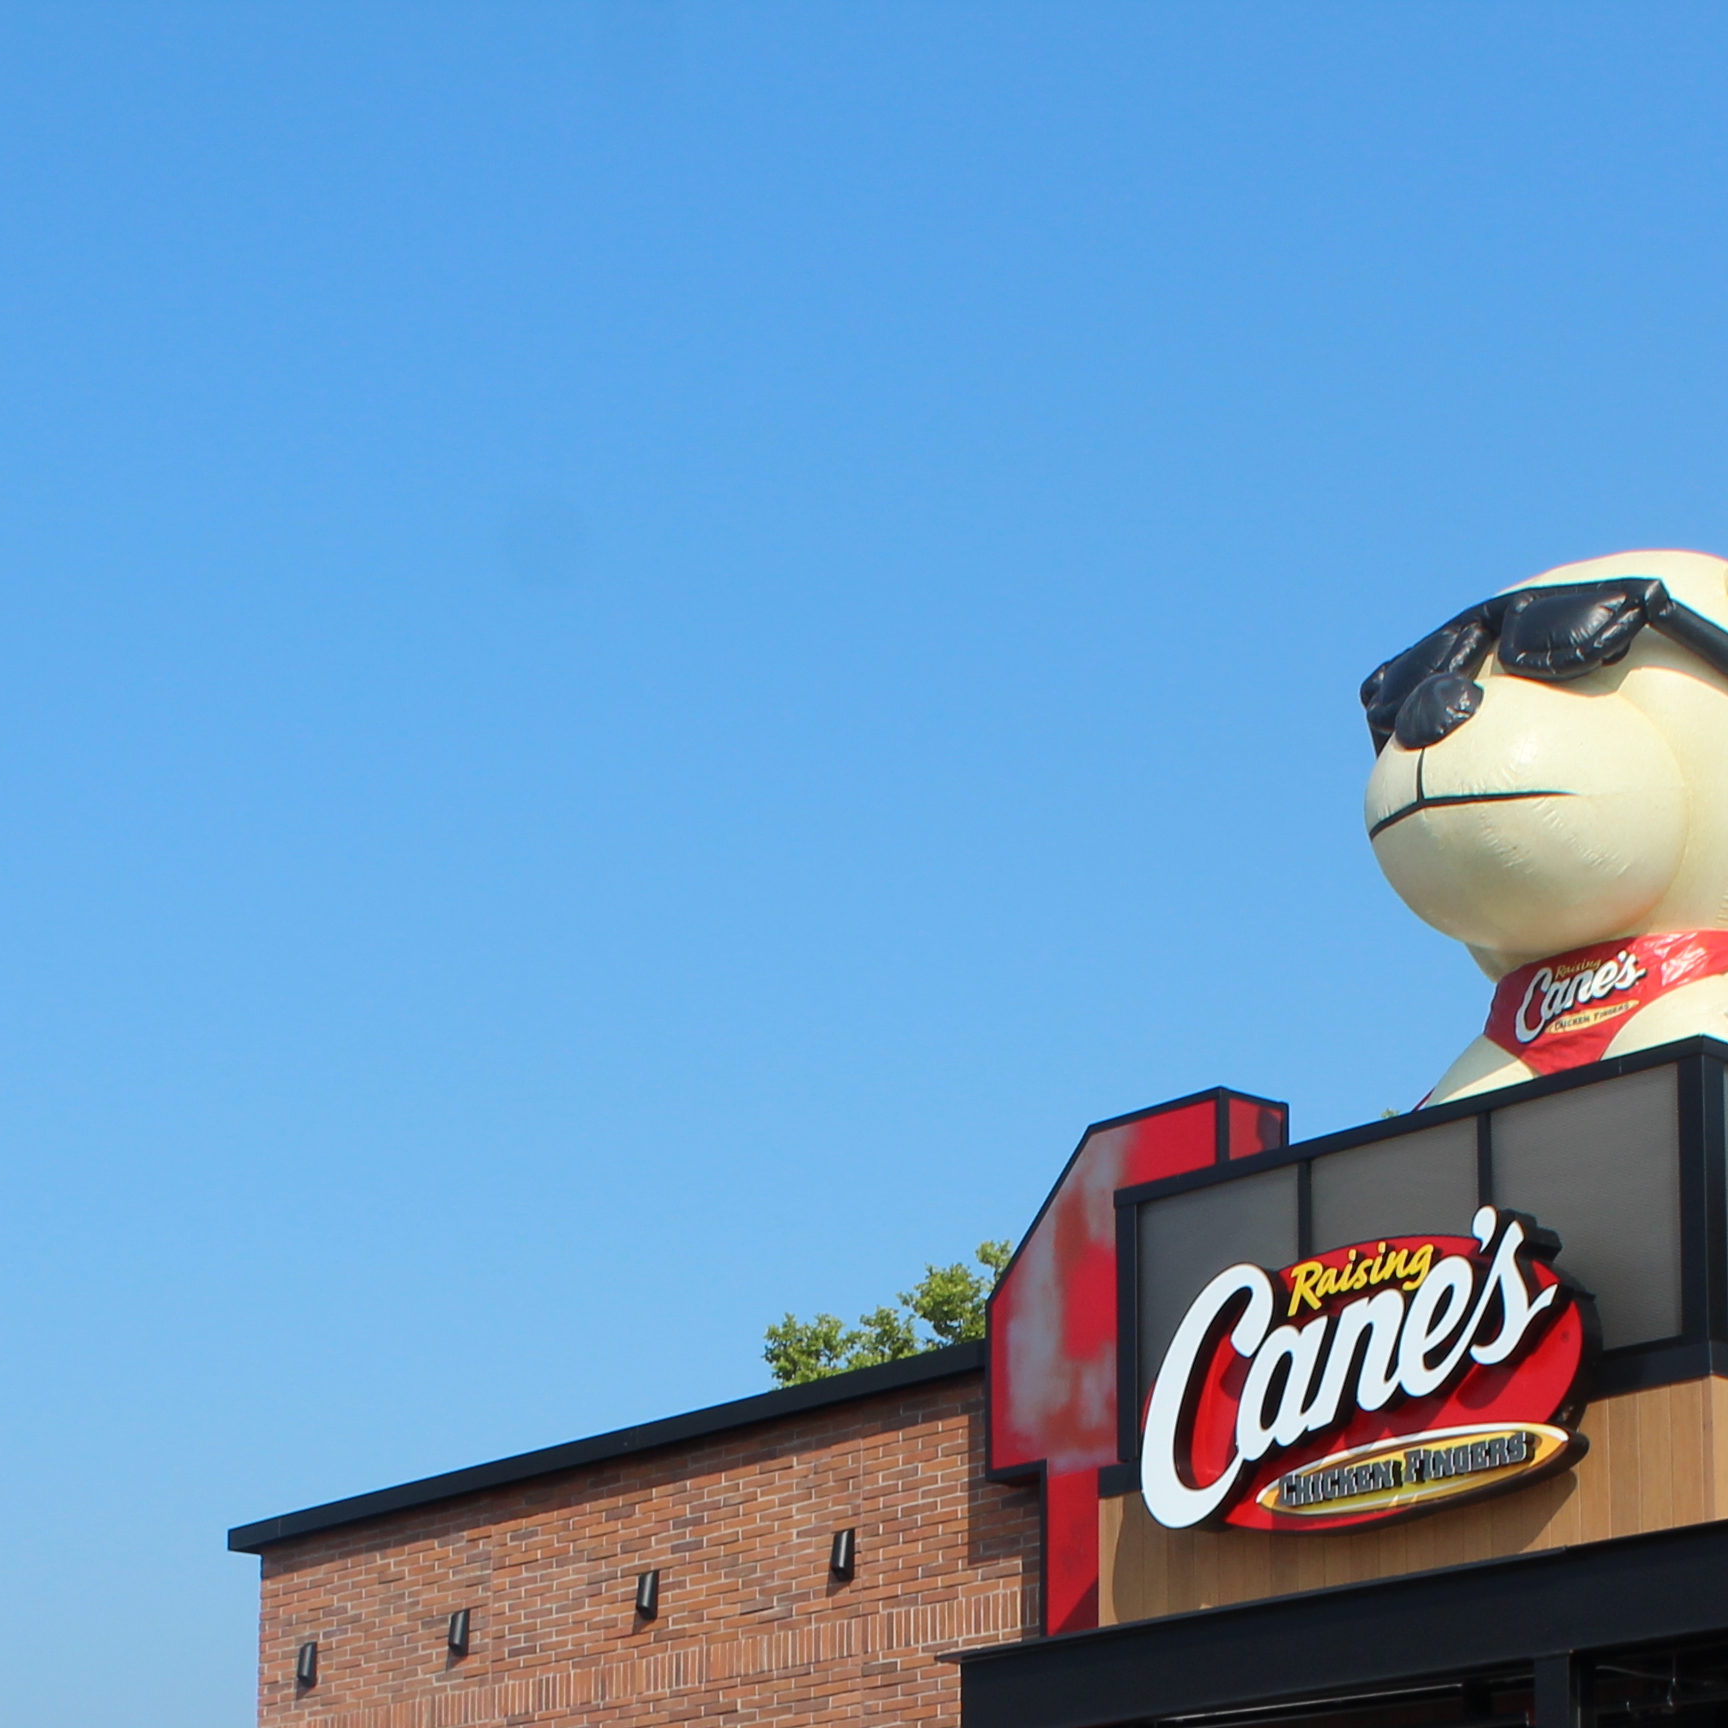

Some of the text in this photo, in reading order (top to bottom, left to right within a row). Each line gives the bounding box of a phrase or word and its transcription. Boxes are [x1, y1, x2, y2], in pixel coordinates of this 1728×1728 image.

[1515, 950, 1647, 1043] Cane's
[1287, 1241, 1434, 1317] Raising
[1141, 1205, 1558, 1529] Cane's
[1278, 1431, 1532, 1507] CHICKEN FINGERS
